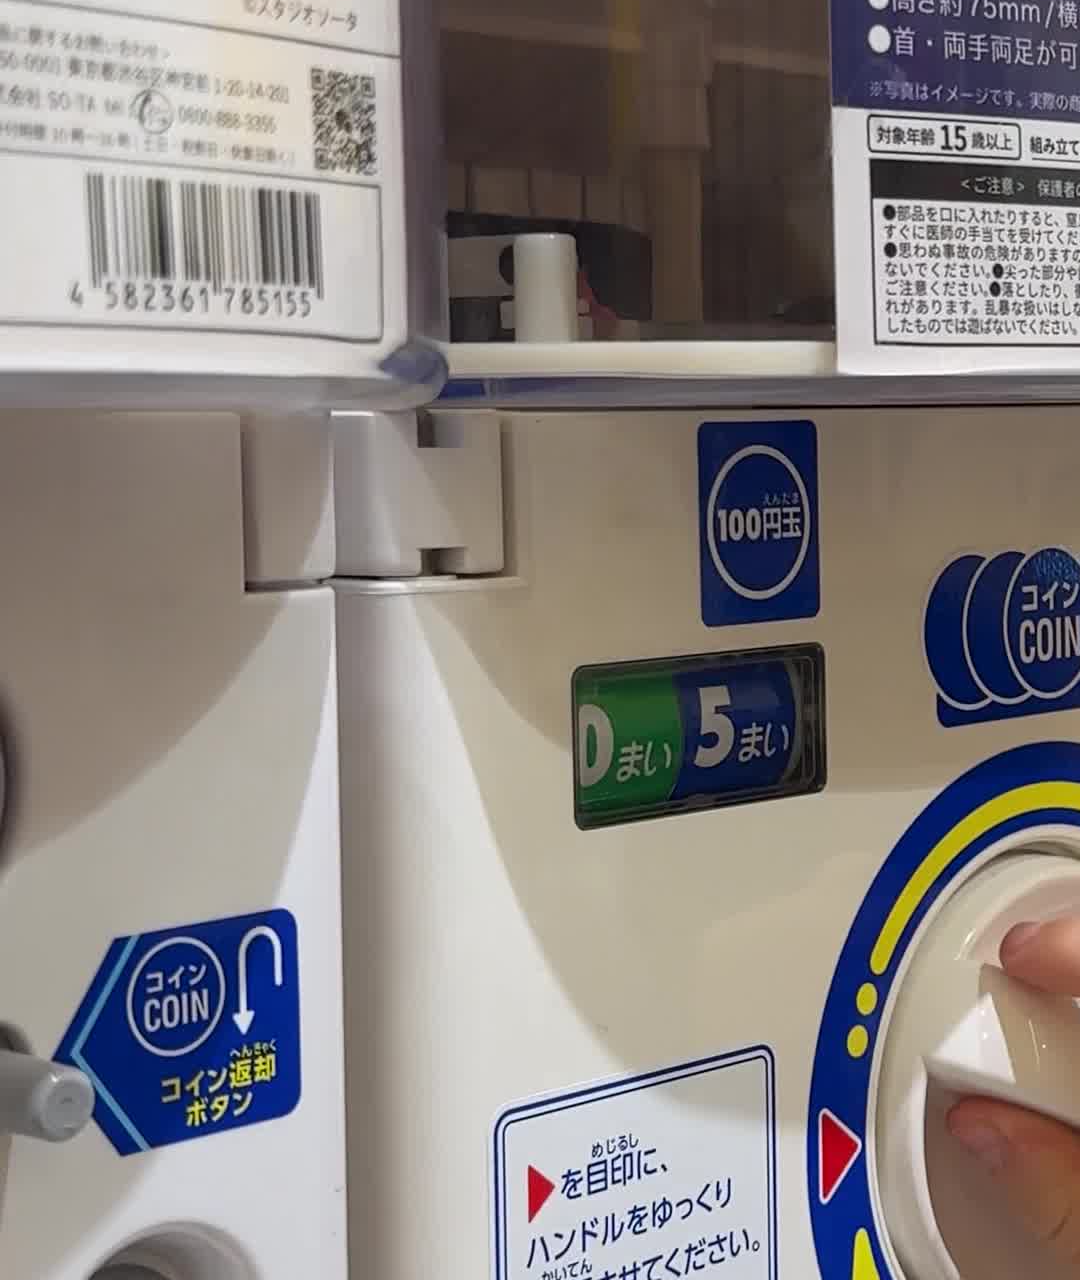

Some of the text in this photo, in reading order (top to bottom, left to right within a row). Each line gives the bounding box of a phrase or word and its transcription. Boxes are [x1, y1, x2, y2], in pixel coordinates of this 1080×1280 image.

[104, 281, 209, 314] 582361
[222, 286, 312, 319] 785155
[717, 506, 802, 542] 100円玉
[1021, 581, 1080, 612] コイン
[694, 685, 790, 769] 5まい
[145, 963, 208, 995] コイン
[143, 987, 210, 1034] COIN
[160, 1053, 278, 1104] コイン返却
[185, 1090, 254, 1128] ボタン
[591, 1132, 640, 1159] めじるし
[560, 1147, 668, 1201] を目印に、
[526, 1176, 734, 1270] ハンドルをゆっくり
